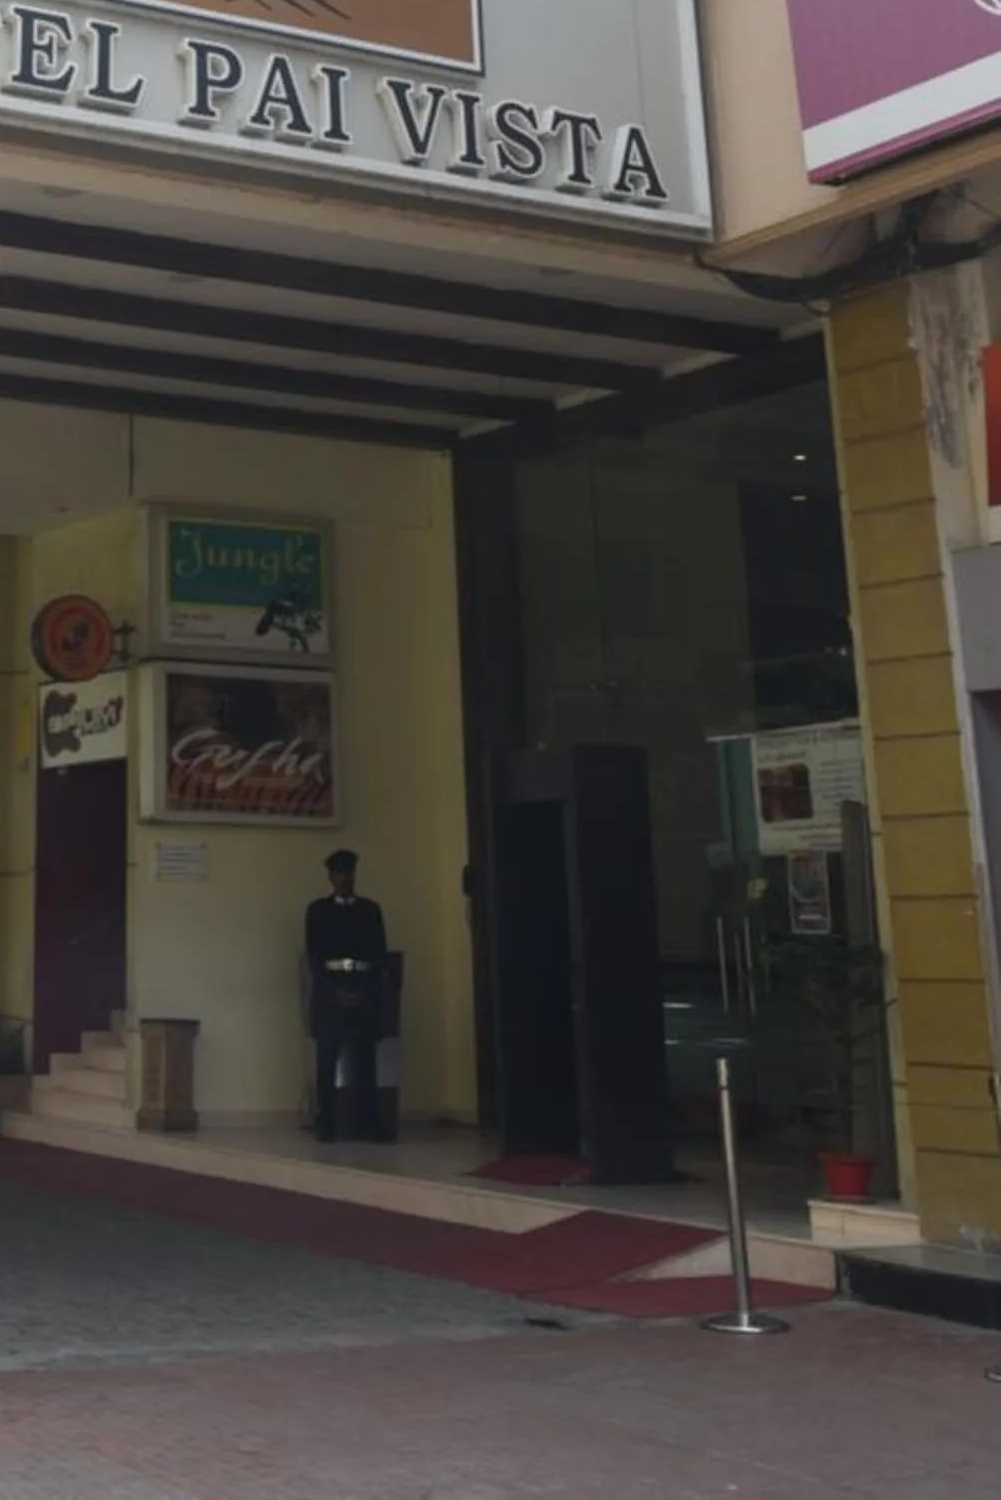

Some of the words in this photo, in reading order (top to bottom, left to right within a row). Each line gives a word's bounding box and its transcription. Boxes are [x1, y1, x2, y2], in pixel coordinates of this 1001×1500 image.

[177, 39, 354, 150] PAI
[380, 78, 670, 207] VISTA
[174, 527, 316, 587] Jungle
